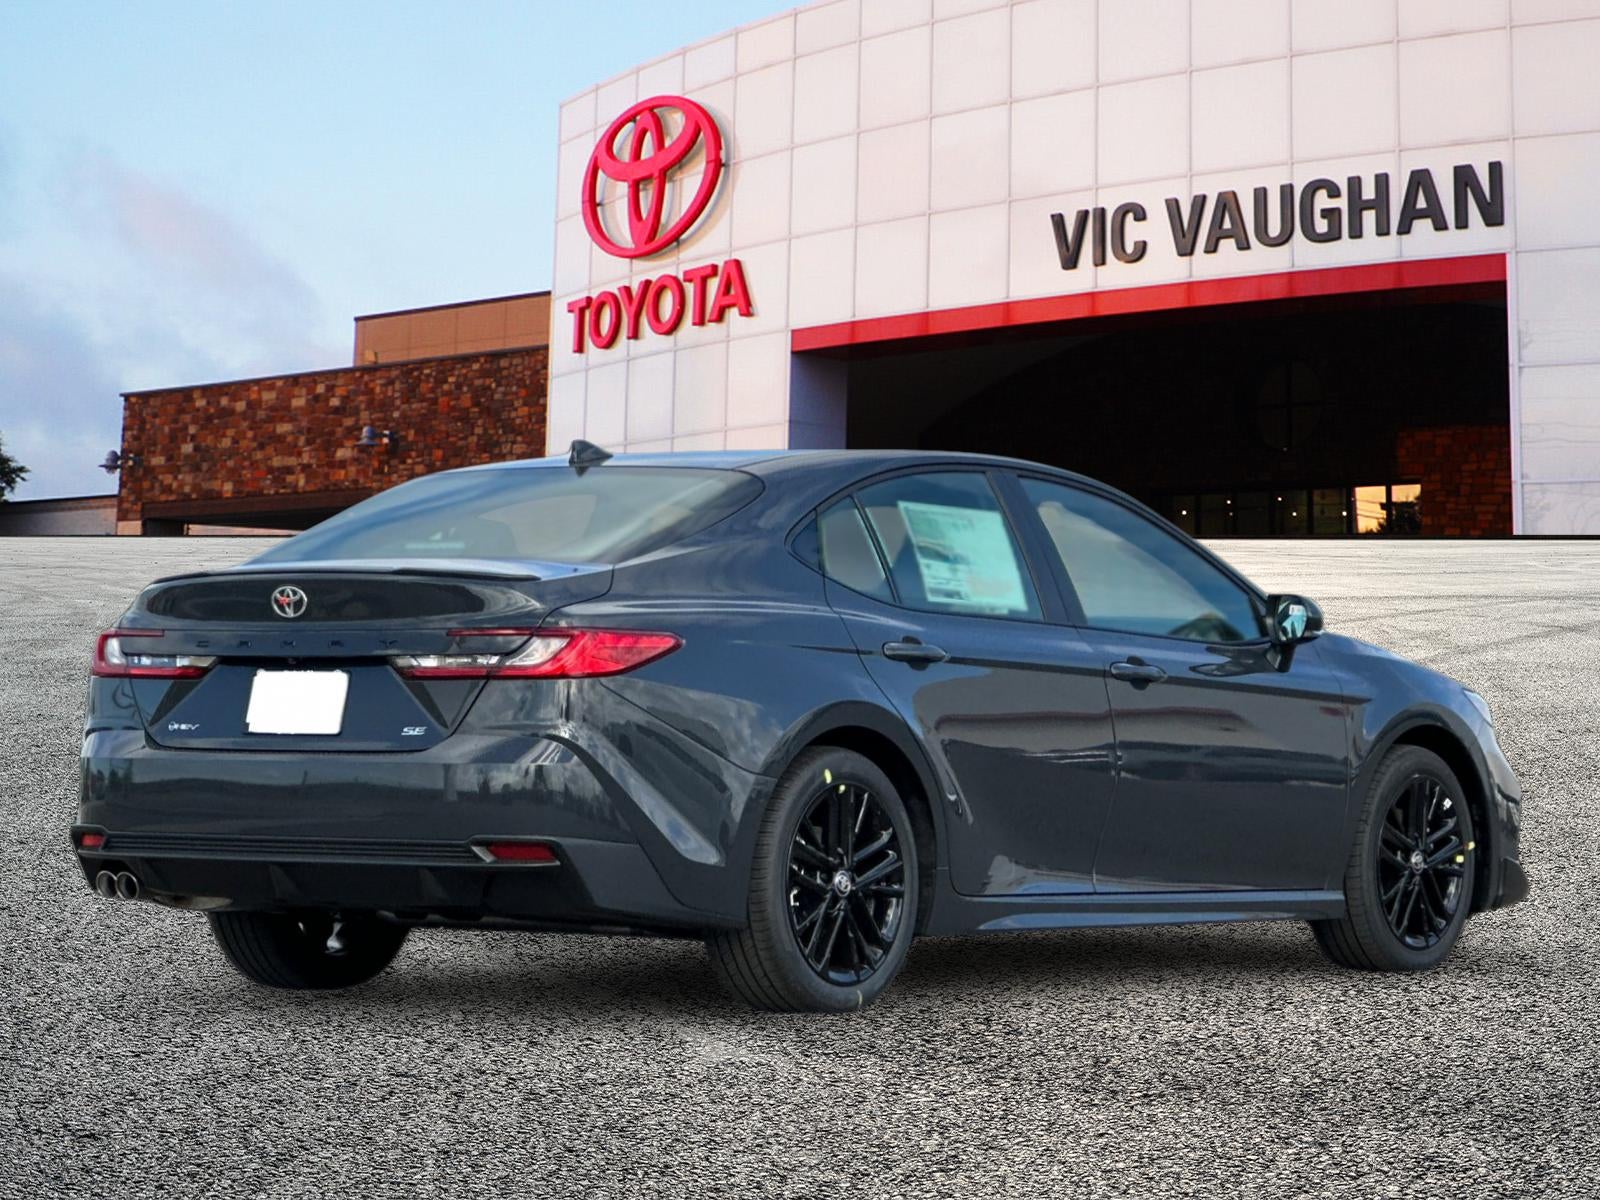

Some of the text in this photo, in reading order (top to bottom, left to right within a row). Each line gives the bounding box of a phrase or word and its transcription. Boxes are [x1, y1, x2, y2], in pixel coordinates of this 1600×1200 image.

[1050, 161, 1505, 271] VIC VAUGHAN
[567, 259, 755, 354] TOYOTA
[401, 726, 428, 736] SE
